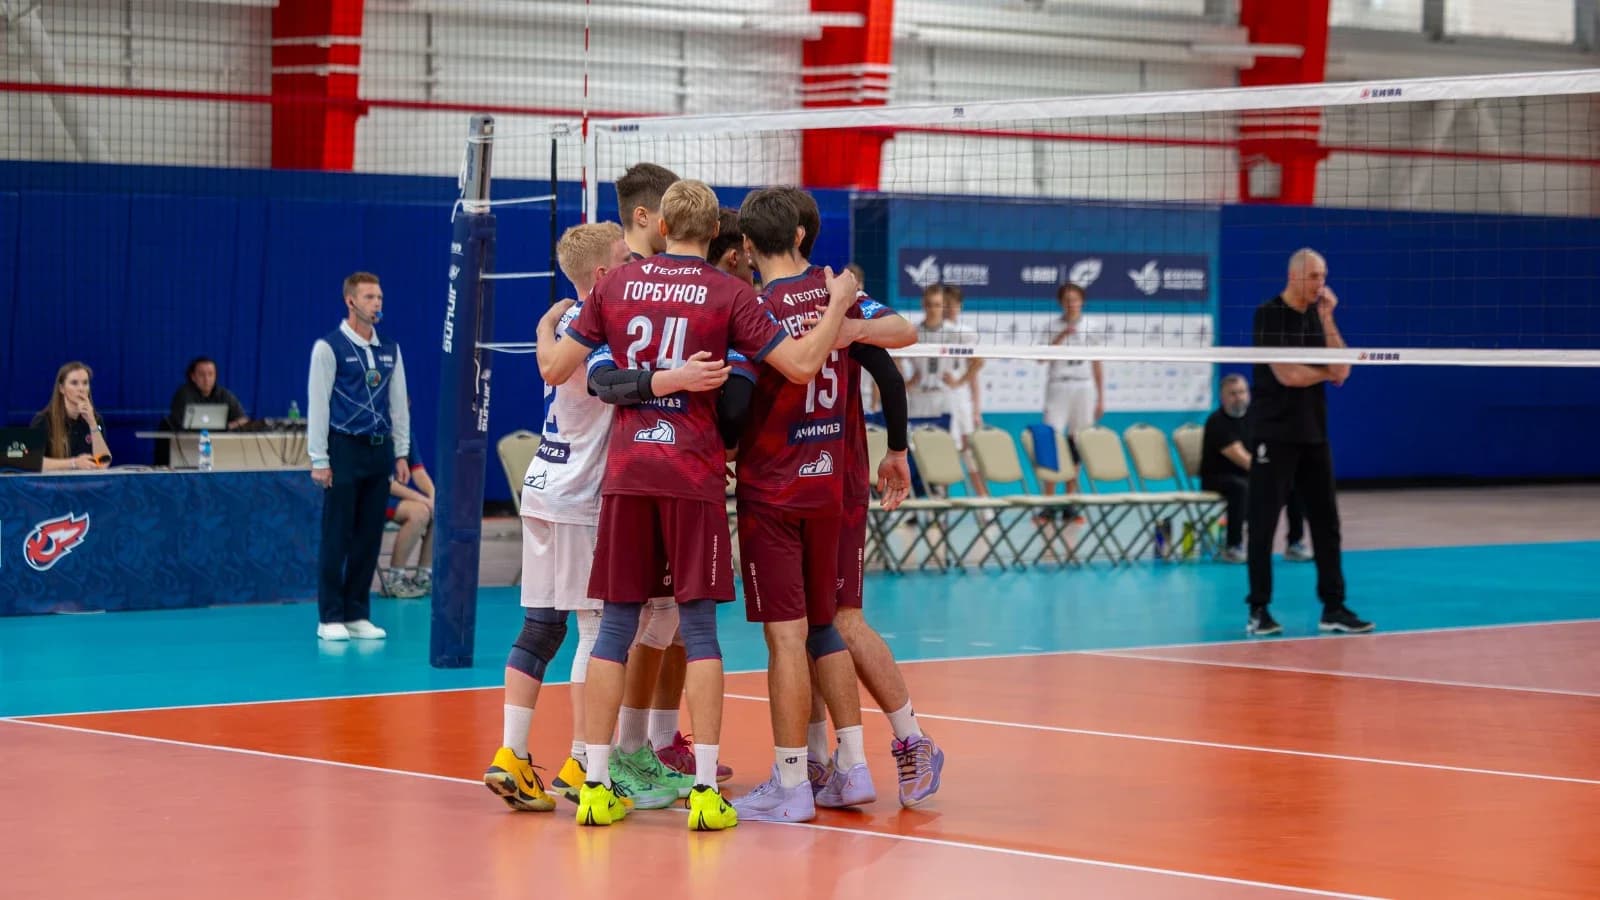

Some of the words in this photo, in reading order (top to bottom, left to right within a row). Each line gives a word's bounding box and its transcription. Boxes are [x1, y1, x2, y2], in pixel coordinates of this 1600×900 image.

[653, 266, 702, 275] ГЕОТЕК
[623, 281, 708, 305] ГОРБУНОВ
[791, 287, 830, 304] ГЕОТЕК
[626, 315, 690, 371] 24
[794, 422, 841, 440] АЧИМГАЗ
